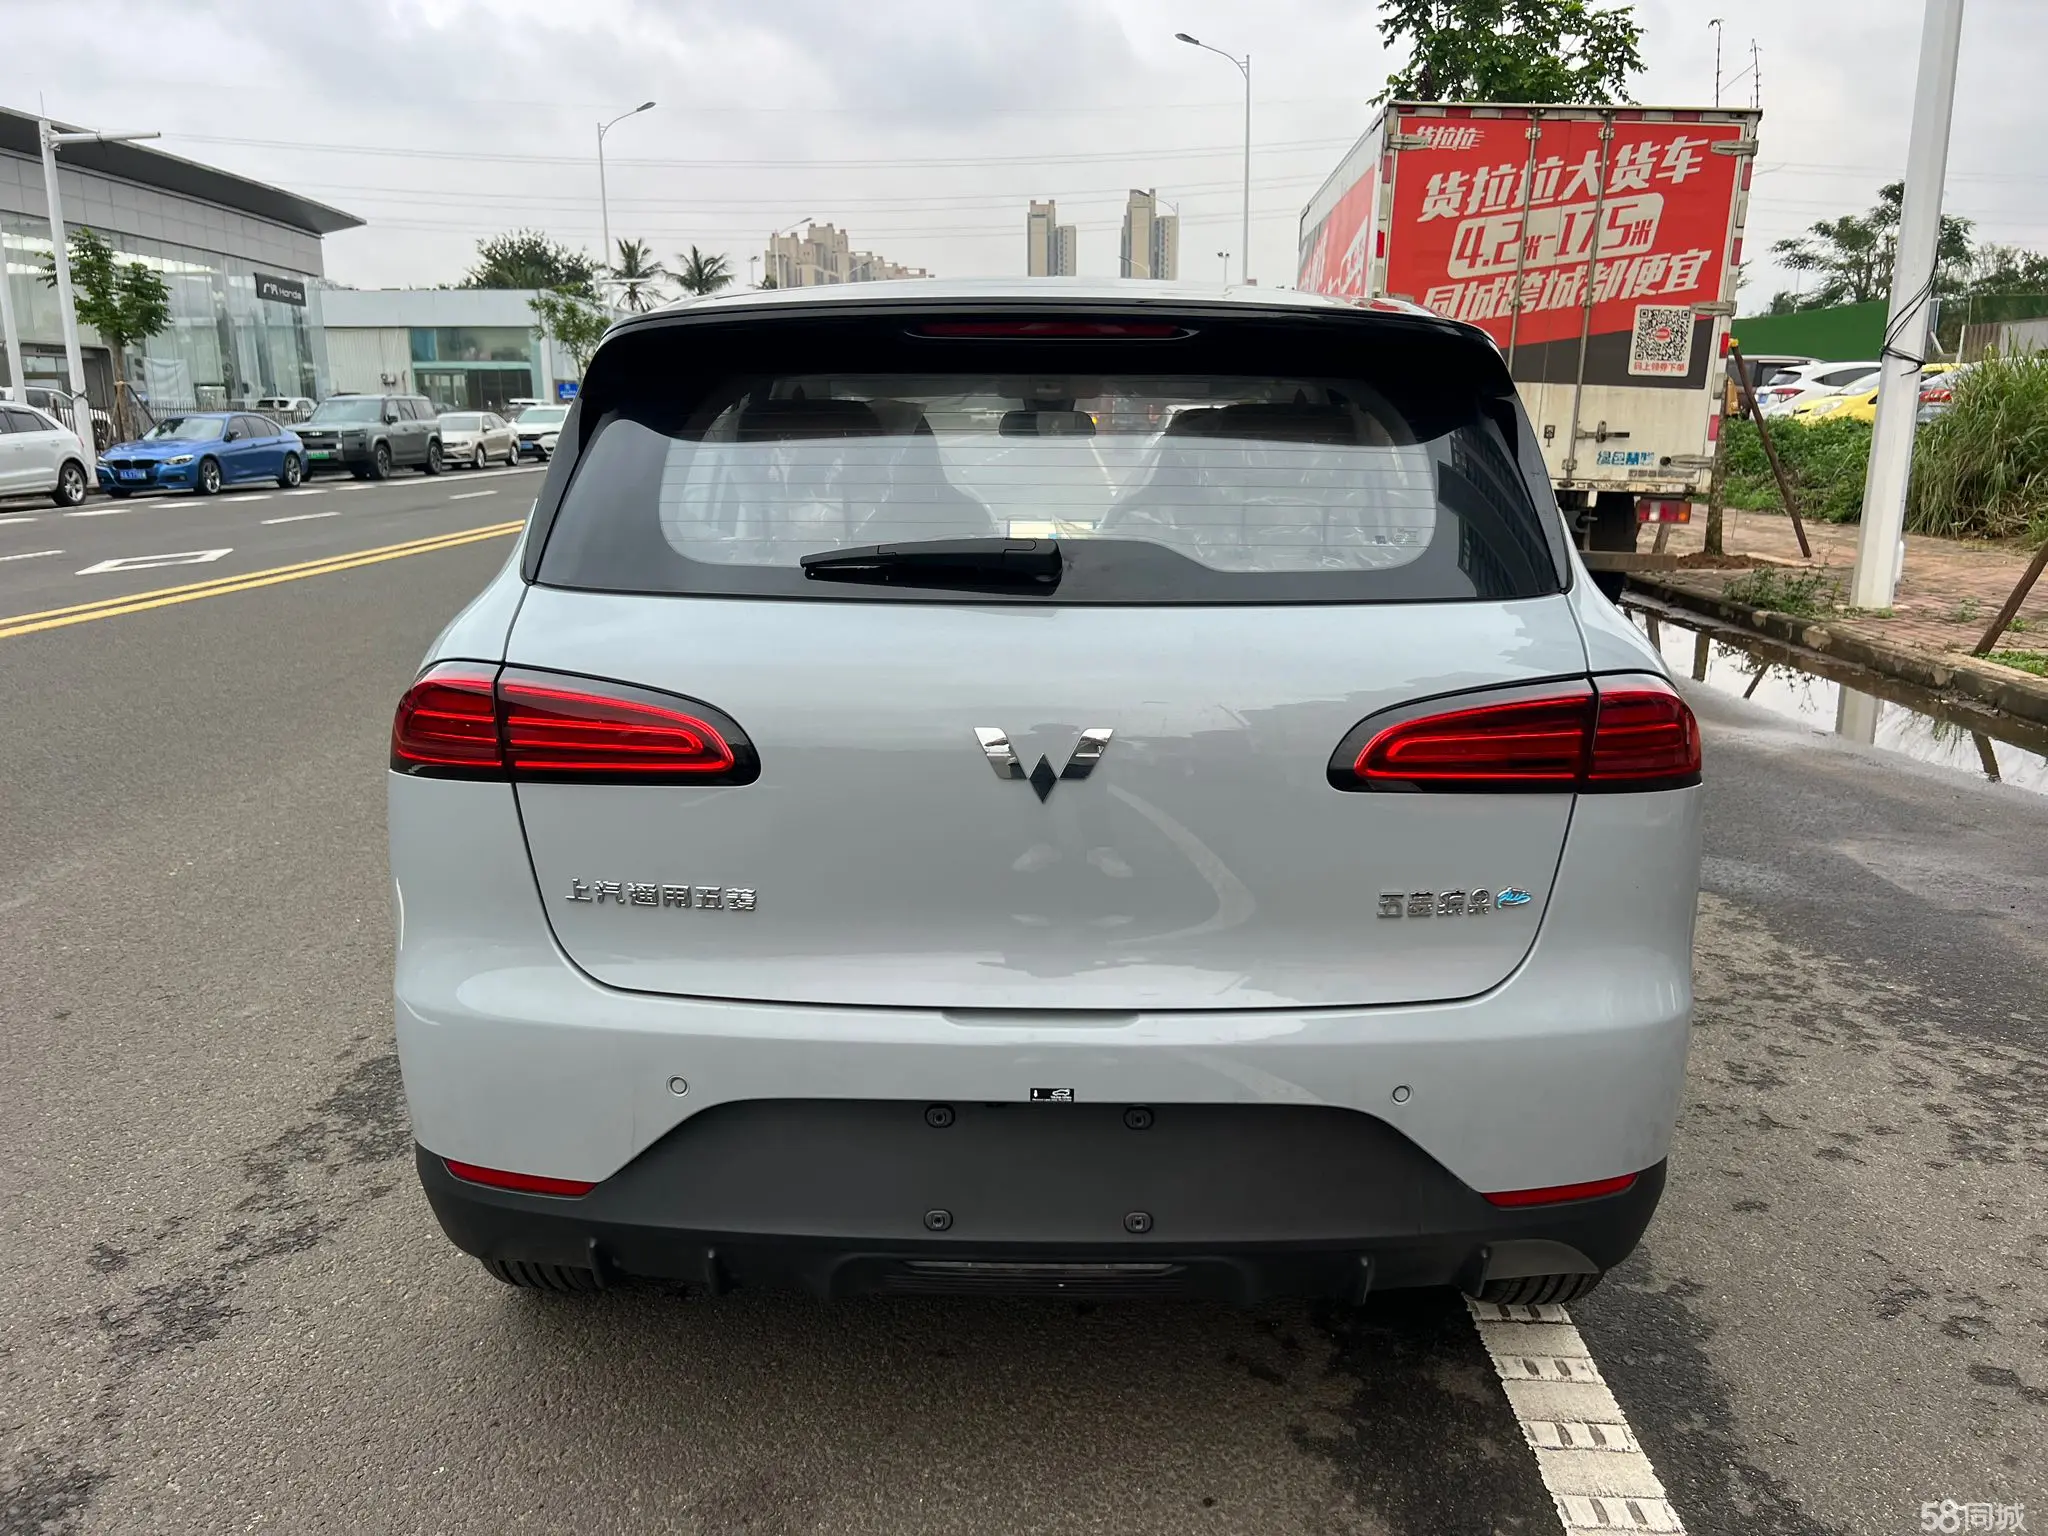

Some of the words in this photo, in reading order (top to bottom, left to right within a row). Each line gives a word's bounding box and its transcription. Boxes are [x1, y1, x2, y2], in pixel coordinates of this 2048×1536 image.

[1417, 136, 1709, 222] 货拉拉大货车
[1422, 248, 1711, 322] 同城跨城都便宜
[564, 877, 757, 911] 上汽通用五菱
